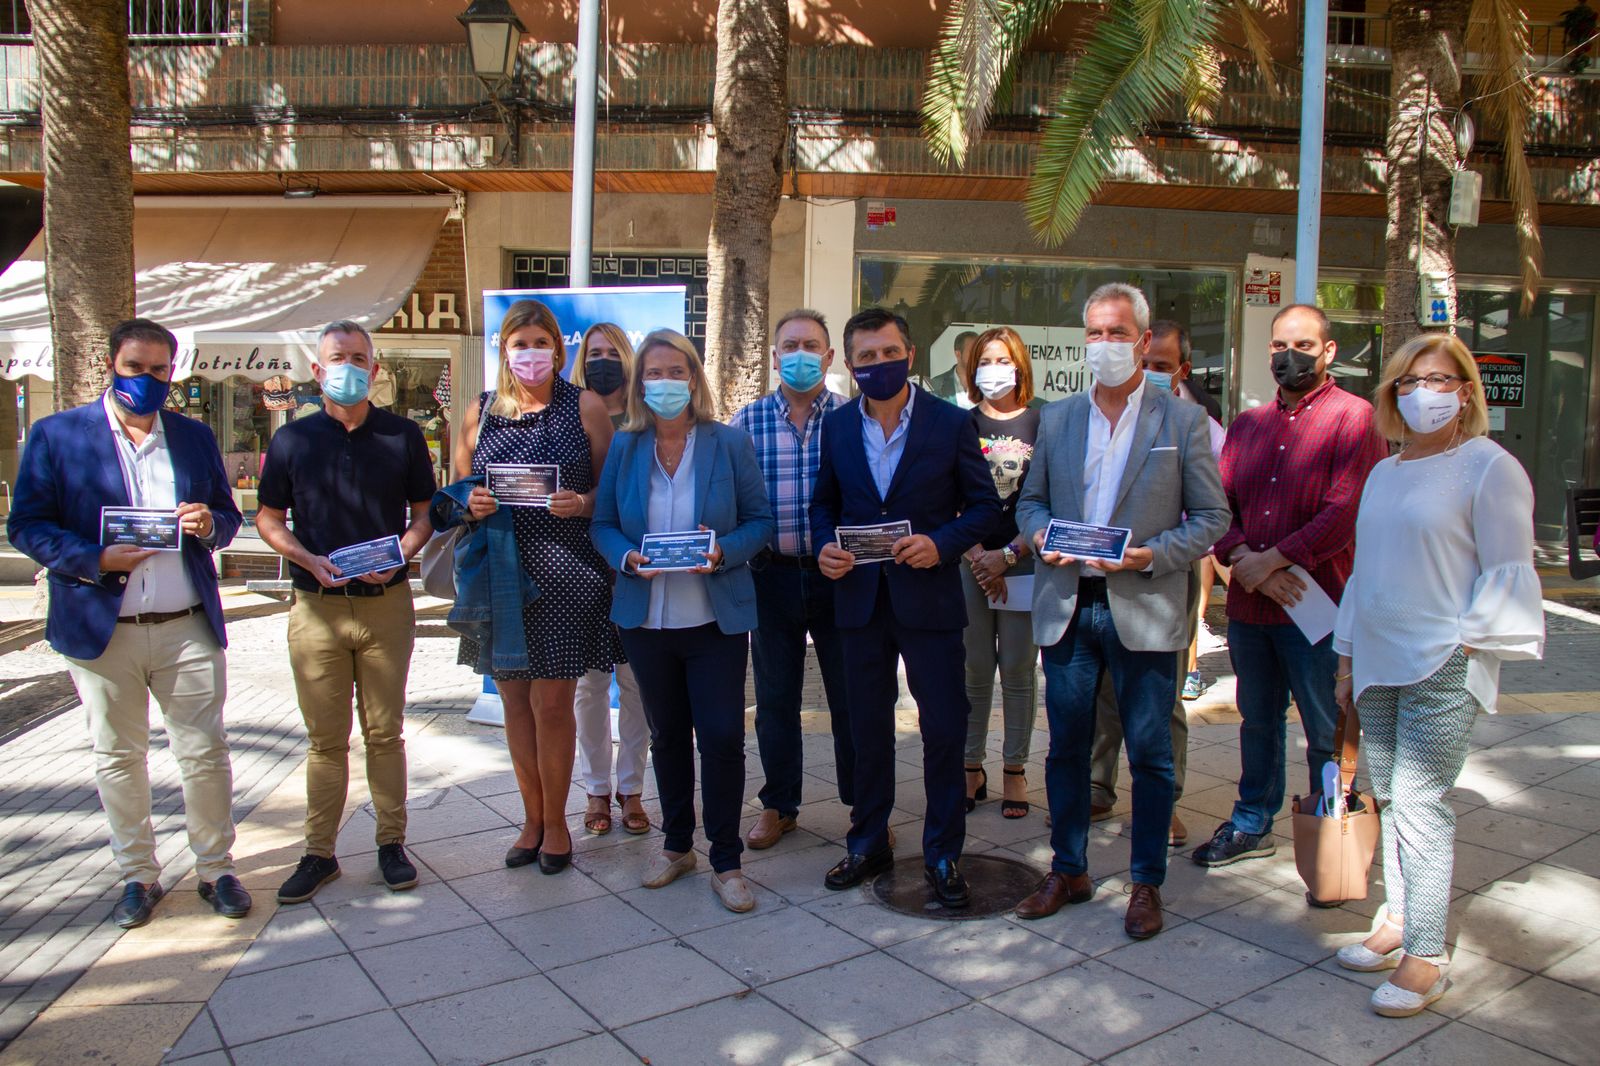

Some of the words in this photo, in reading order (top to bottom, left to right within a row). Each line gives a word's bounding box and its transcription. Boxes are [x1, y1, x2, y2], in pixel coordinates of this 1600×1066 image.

[179, 347, 293, 372] Motrileña
[1066, 346, 1081, 361] TU
[1043, 366, 1084, 393] AQUÍ
[1502, 387, 1521, 400] 757
